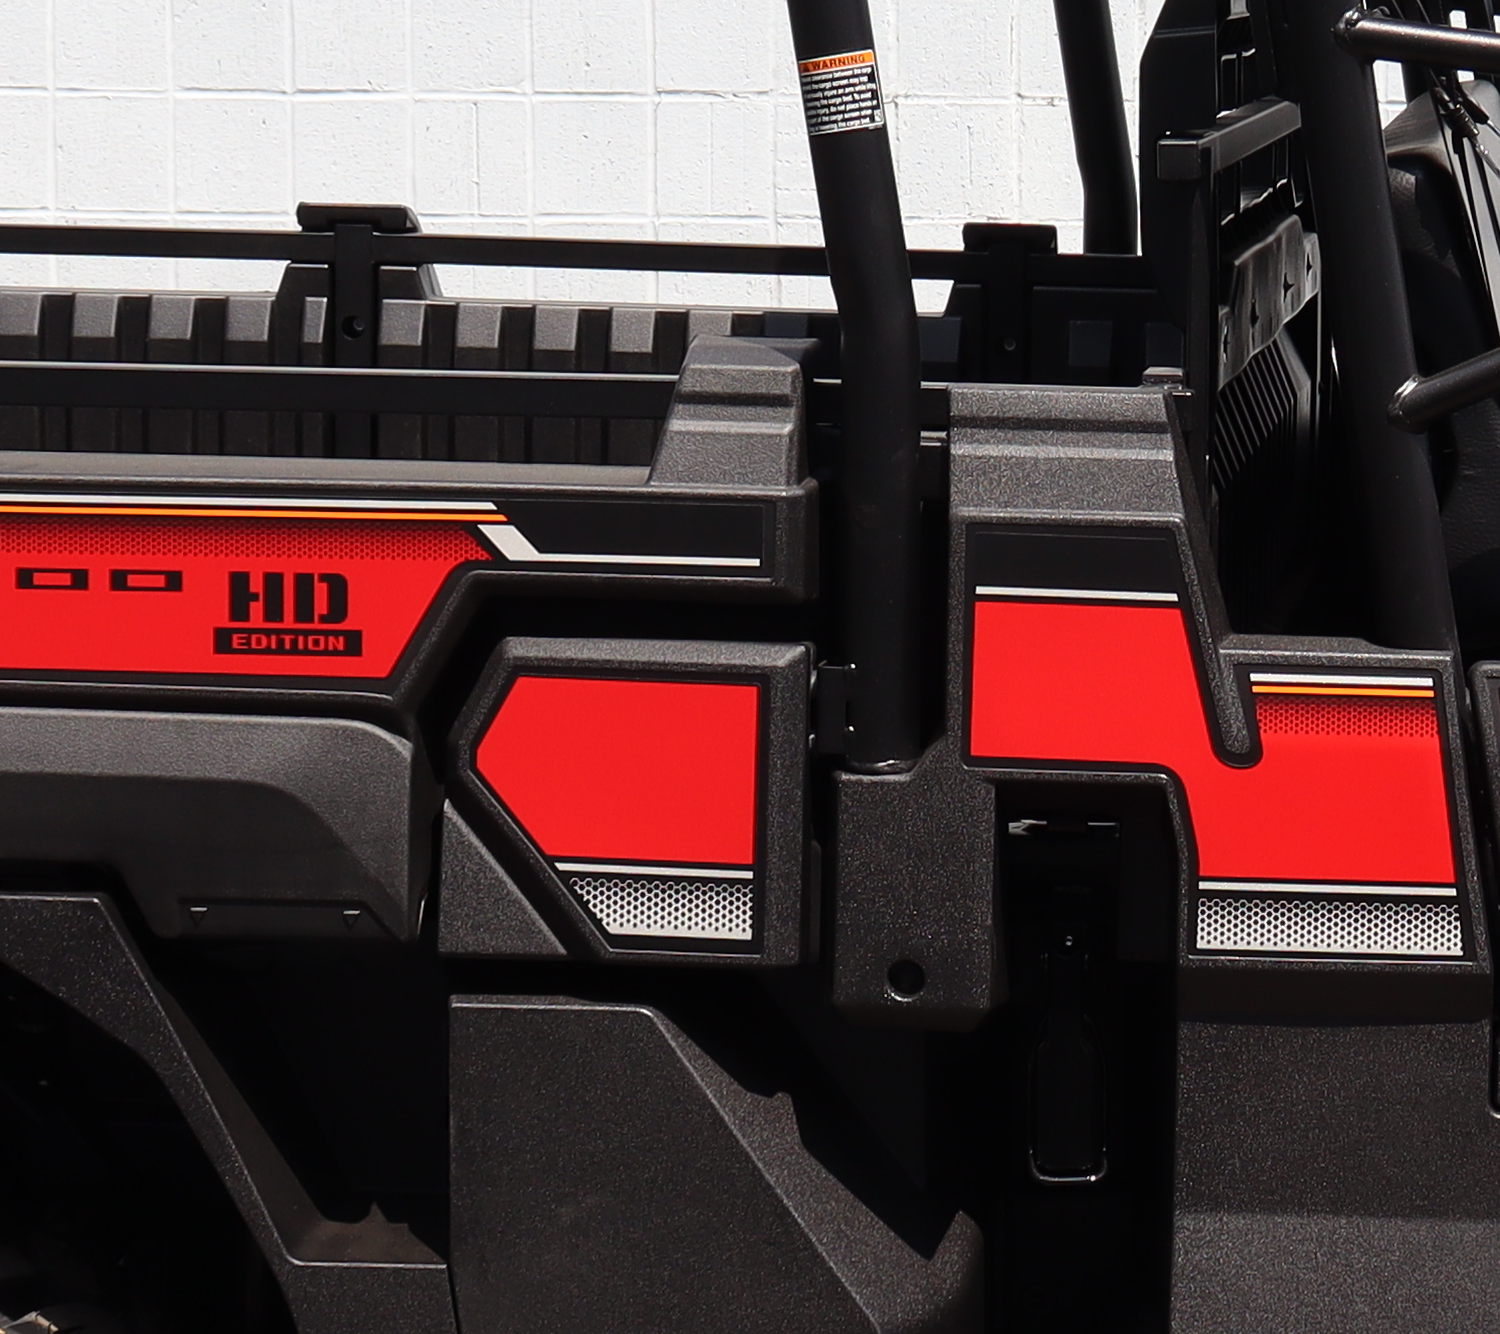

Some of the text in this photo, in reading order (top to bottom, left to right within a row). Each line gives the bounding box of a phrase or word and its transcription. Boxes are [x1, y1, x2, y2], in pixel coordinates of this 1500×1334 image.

[813, 54, 865, 70] WARNING
[228, 570, 348, 625] HD
[231, 633, 345, 652] EDITION
